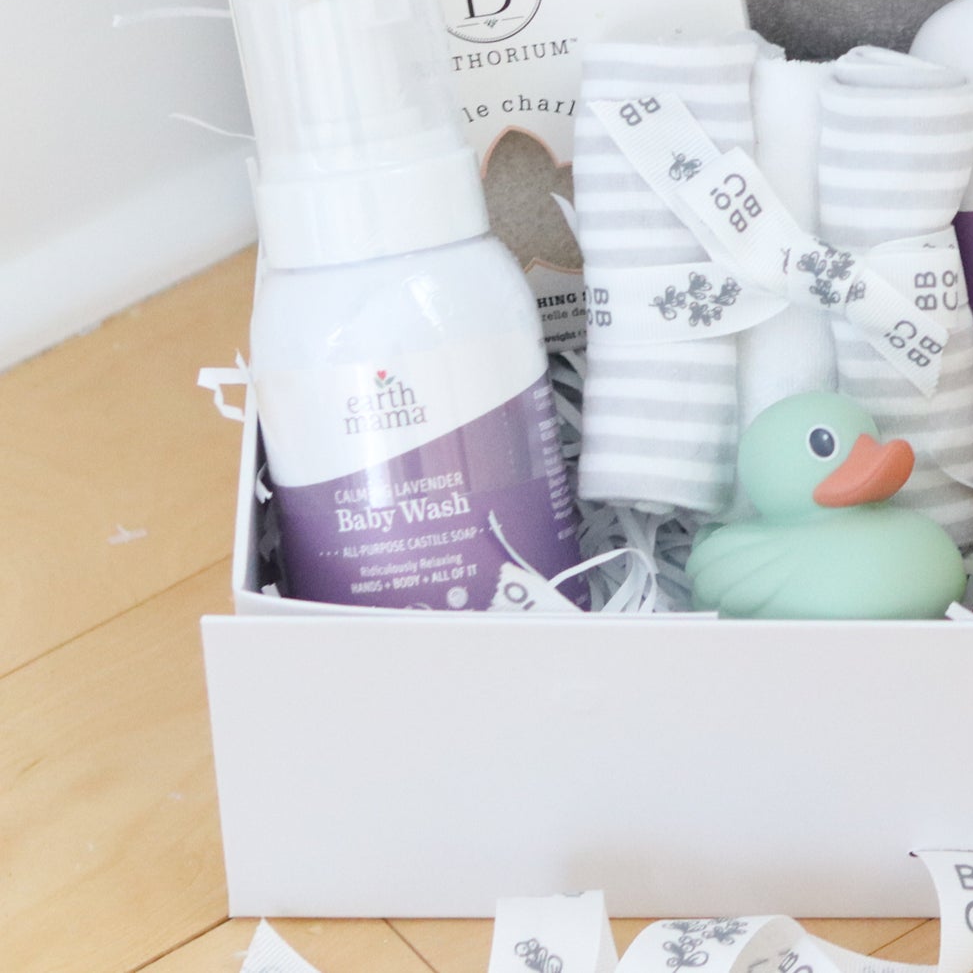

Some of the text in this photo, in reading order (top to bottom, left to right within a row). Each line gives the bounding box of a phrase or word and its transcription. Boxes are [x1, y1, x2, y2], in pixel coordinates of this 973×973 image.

[452, 38, 570, 72] THORIUM
[501, 94, 576, 118] charl
[343, 403, 428, 435] mama
[394, 471, 464, 497] LAVENDER
[335, 491, 471, 533] Baby Wash
[407, 533, 449, 550] CASTILE
[450, 526, 478, 542] SOAP
[351, 579, 384, 594] HANDS
[392, 574, 420, 590] BODY
[431, 568, 450, 583] ALL
[450, 566, 466, 580] OF
[466, 563, 478, 577] IT
